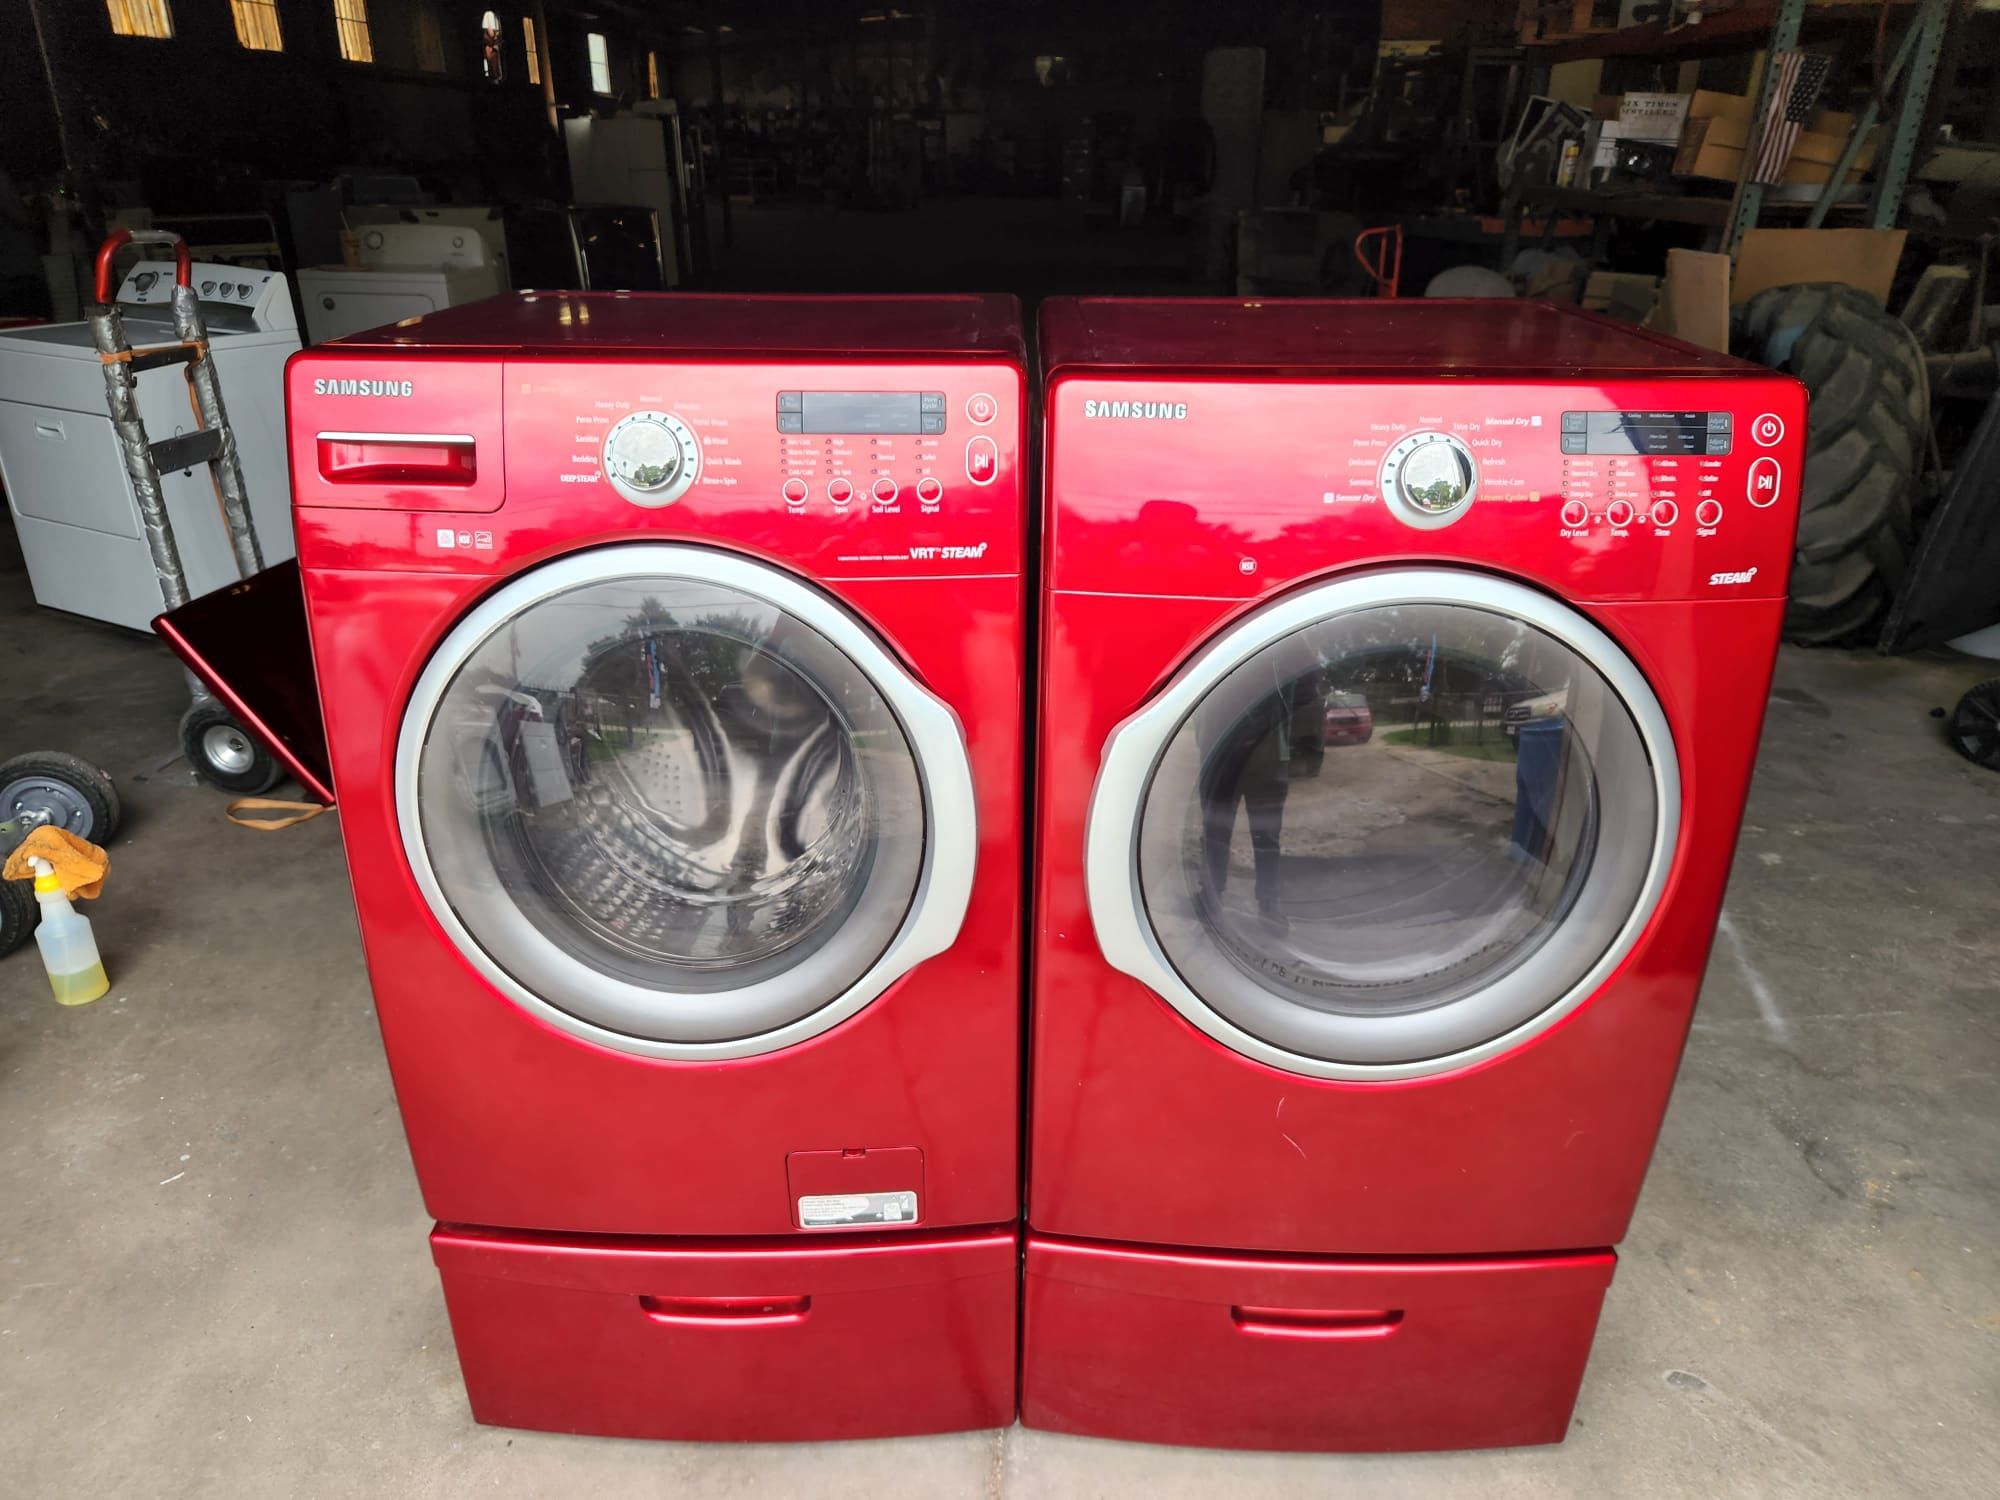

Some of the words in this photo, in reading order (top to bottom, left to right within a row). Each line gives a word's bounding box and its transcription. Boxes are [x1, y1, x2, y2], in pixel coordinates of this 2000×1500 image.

[314, 378, 414, 398] SAMSUNG
[1085, 399, 1188, 420] SAMSUNG
[1419, 415, 1442, 424] Normal
[1485, 416, 1514, 426] Manual
[1515, 417, 1530, 428] Dry
[1370, 423, 1390, 433] Heavy
[1391, 423, 1407, 433] Duty
[1453, 422, 1469, 432] Time
[1469, 422, 1481, 433] Dry
[575, 435, 600, 443] Sanitize
[1353, 439, 1369, 448] Perm
[1472, 438, 1487, 448] Quick
[1488, 438, 1503, 449] Dry
[572, 454, 598, 464] Bedding
[1482, 457, 1506, 466] Refresh
[560, 474, 576, 482] DEEP
[1336, 493, 1360, 503] Sensor
[1361, 493, 1377, 504] Dry
[1480, 494, 1504, 503] Steam
[871, 505, 884, 514] Soil
[884, 505, 901, 514] Level
[921, 504, 940, 515] Signal
[1560, 529, 1572, 538] Dry
[1572, 529, 1589, 537] Level
[1610, 529, 1629, 538] Temp.
[1654, 528, 1671, 537] Time
[1696, 527, 1717, 537] Signal
[941, 546, 983, 559] STEAM
[1709, 572, 1753, 586] STEAM
